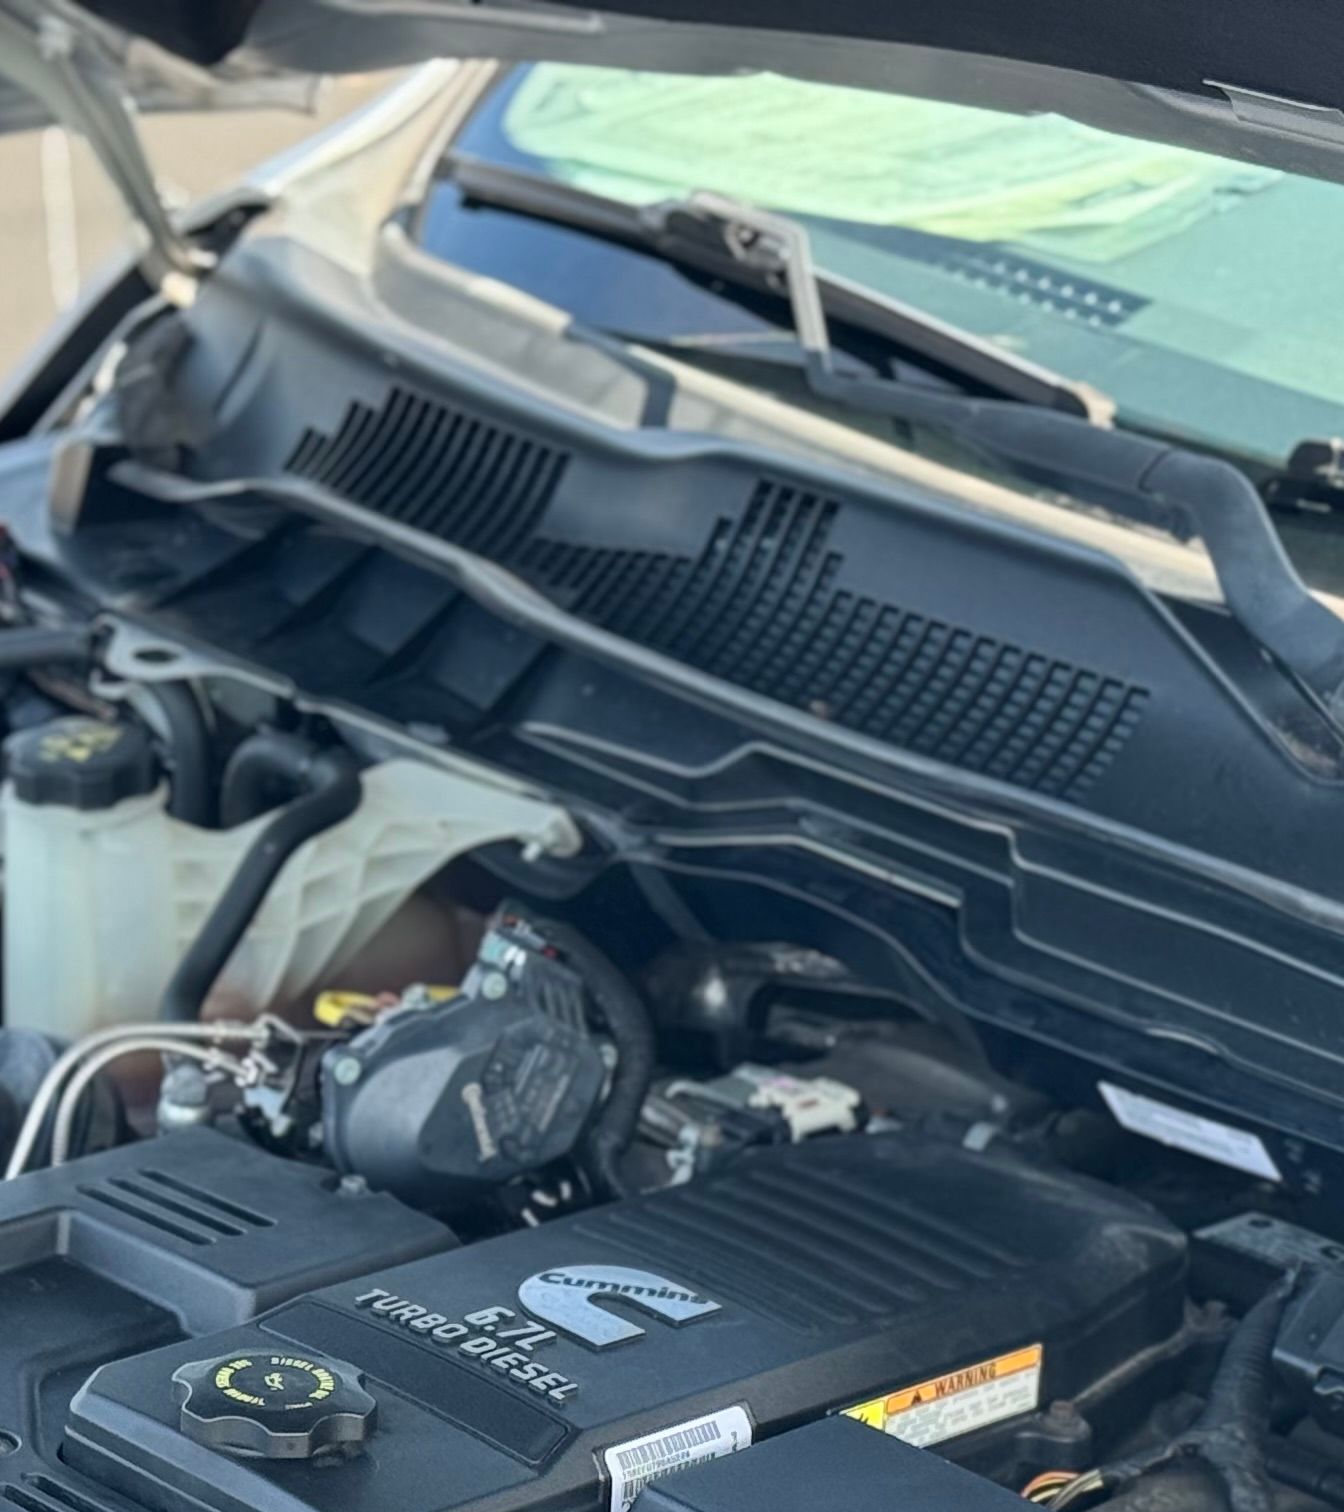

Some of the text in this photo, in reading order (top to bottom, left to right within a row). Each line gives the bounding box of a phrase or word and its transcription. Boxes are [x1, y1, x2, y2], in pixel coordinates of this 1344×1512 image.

[538, 1271, 713, 1307] Cummins
[354, 1287, 579, 1405] TURBO DIESEL
[463, 1305, 557, 1352] 6.7L
[934, 1362, 998, 1399] WARNING
